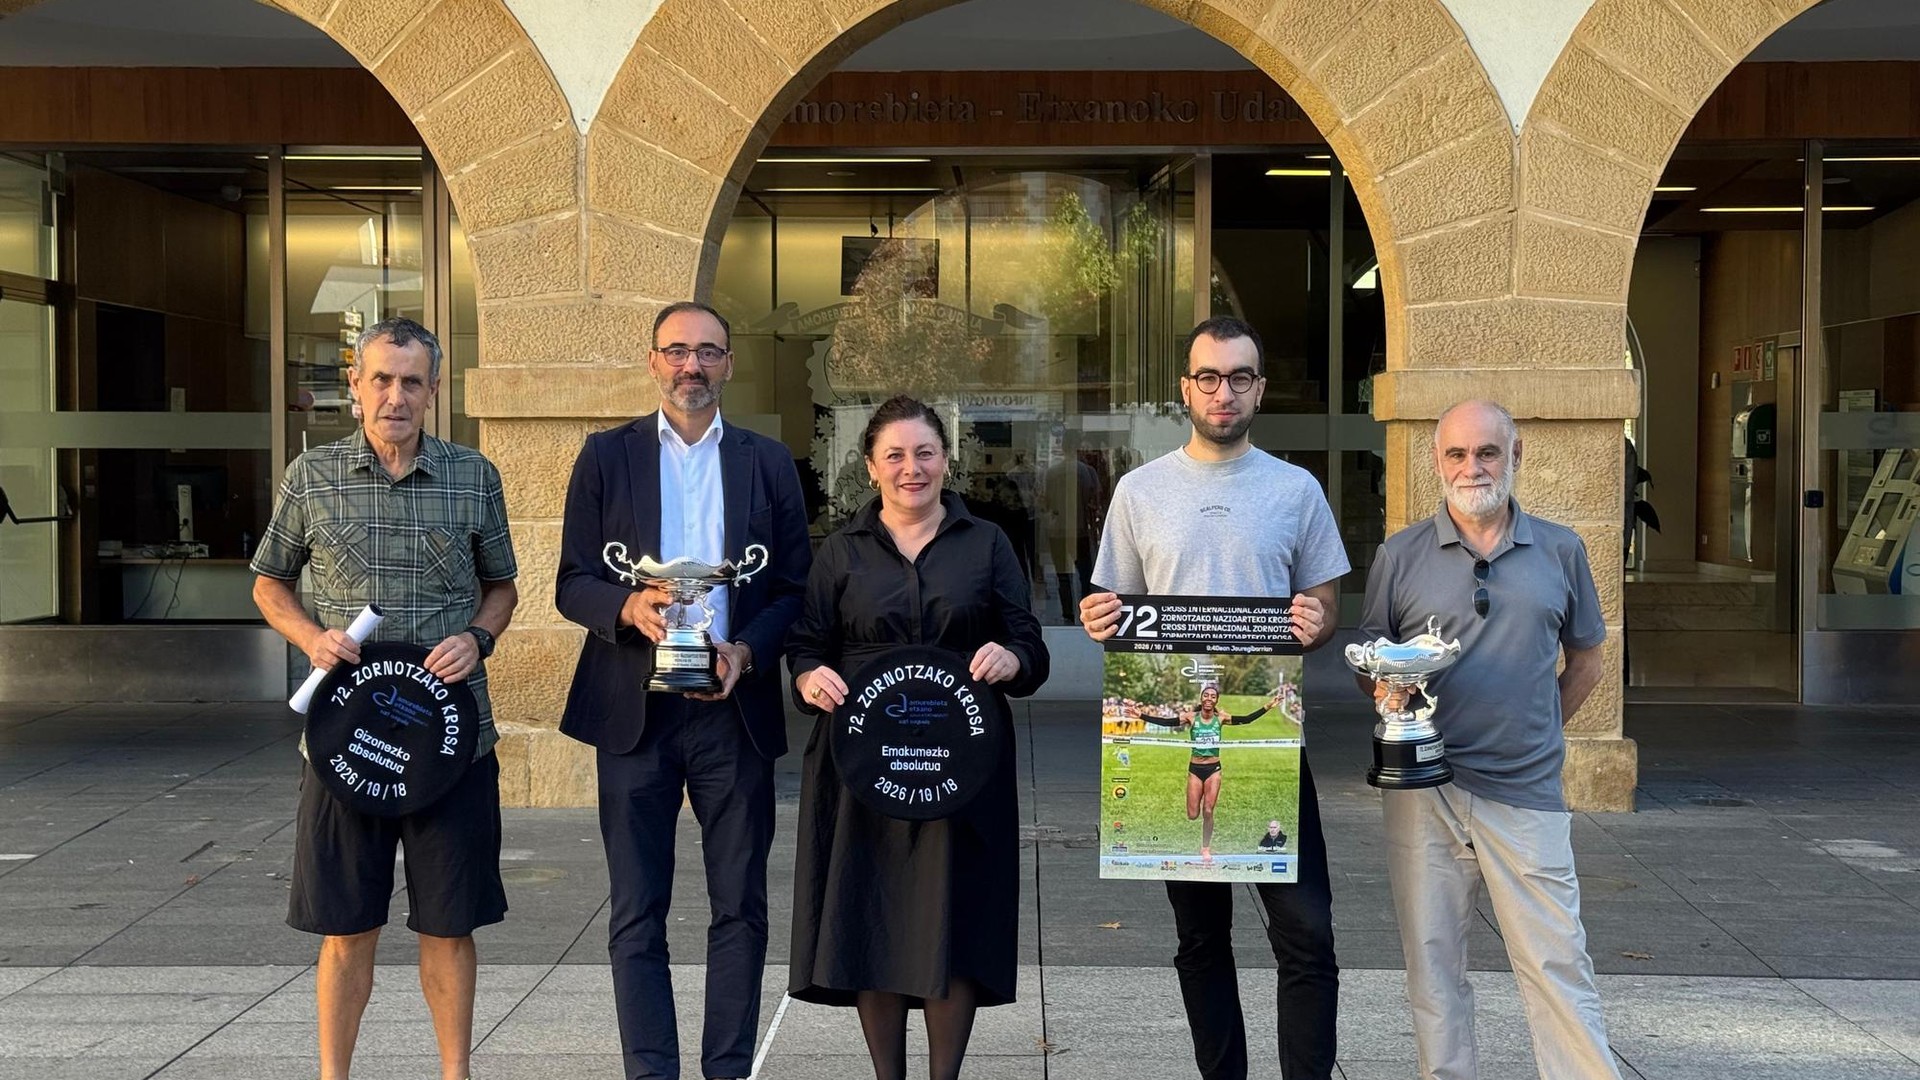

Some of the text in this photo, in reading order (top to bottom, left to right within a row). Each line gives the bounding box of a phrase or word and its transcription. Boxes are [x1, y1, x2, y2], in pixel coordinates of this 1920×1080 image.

[788, 92, 977, 124] morebieta
[1016, 91, 1200, 124] Etxanoko
[884, 301, 946, 321] ETANOKO
[1115, 605, 1158, 638] 72
[1161, 614, 1292, 624] ZORNOTZAKO NAZIOARTEKO KROSA
[1188, 606, 1252, 614] INTERNACIONAL
[1188, 624, 1252, 632] INTERNACIONAL
[1252, 625, 1292, 633] ZORNOTZA
[331, 686, 354, 706] 72.
[351, 660, 449, 701] ZORNOTZAKO
[440, 703, 459, 756] KROSA
[848, 665, 985, 737] 72. ZORNOTZAKO KROSA
[348, 742, 405, 774] absolutua
[354, 728, 411, 762] Gizonezko
[882, 745, 950, 758] Emakumezko
[890, 760, 941, 772] absolutua
